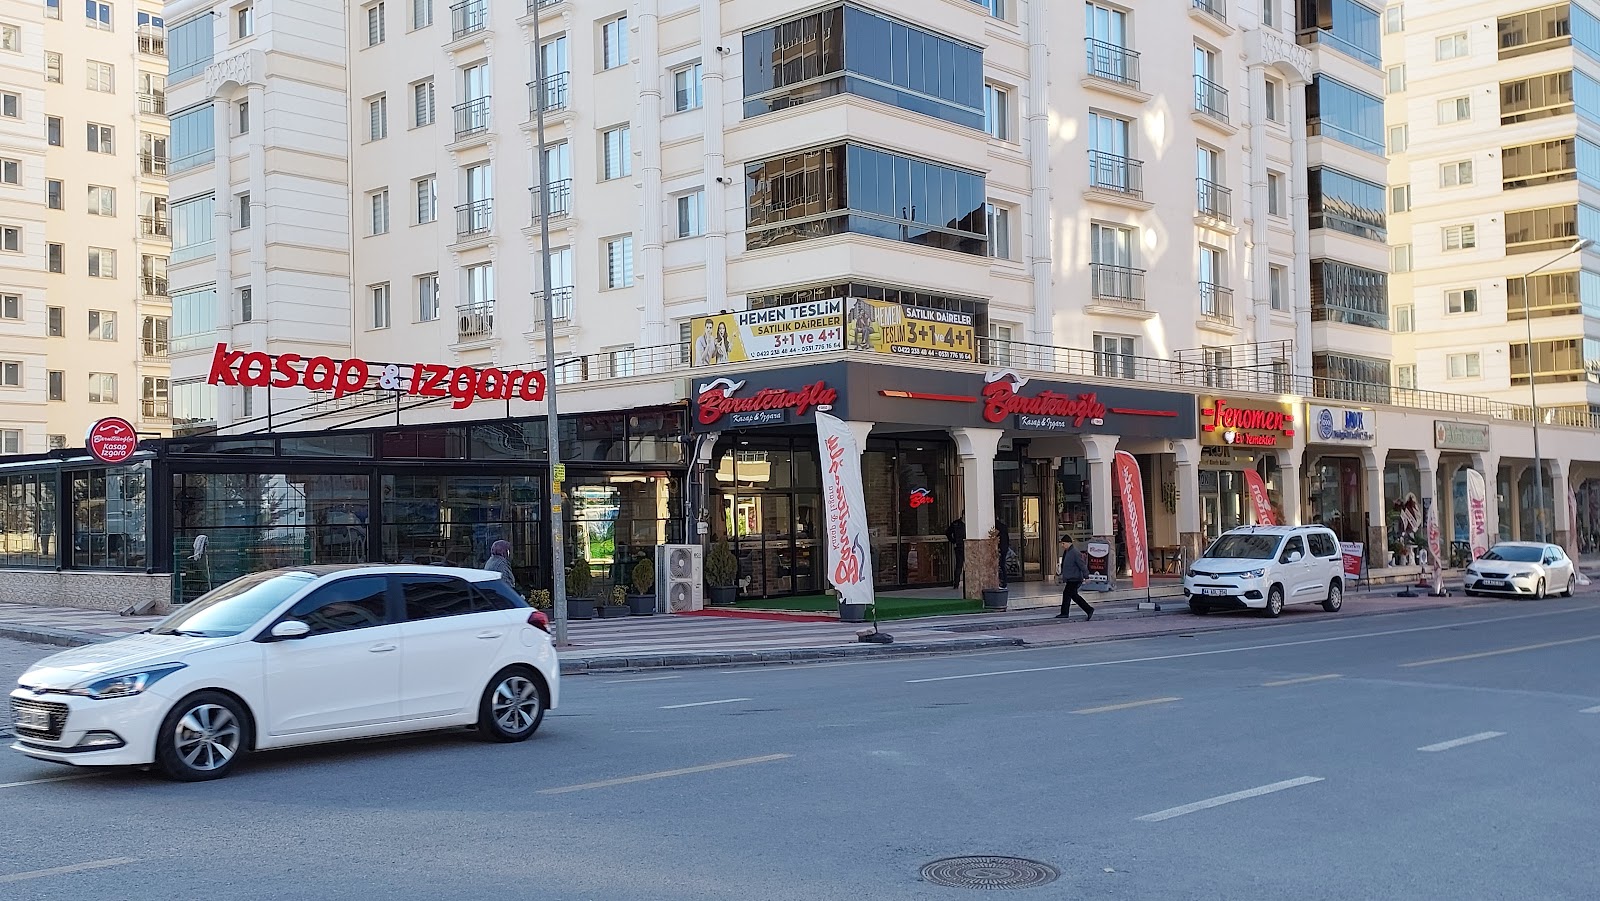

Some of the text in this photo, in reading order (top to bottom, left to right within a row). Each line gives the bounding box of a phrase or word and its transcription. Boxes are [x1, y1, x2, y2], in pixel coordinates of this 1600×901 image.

[740, 308, 786, 326] HEMEN
[874, 305, 902, 326] HEMEN
[906, 307, 935, 321] SATILIK
[758, 324, 791, 335] SATILIK
[907, 322, 936, 346] 3+1
[944, 327, 973, 350] 4+1
[774, 327, 841, 348] 3+1 ve 4+1
[897, 346, 910, 354] 0422
[207, 342, 369, 399] kasap
[379, 364, 401, 390] &
[732, 414, 753, 423] Kasap
[753, 412, 760, 421] &
[1021, 415, 1041, 428] Kasap
[1040, 417, 1046, 427] &
[1213, 399, 1284, 431] Fenomen
[1235, 431, 1277, 446] Ev Yemekleri
[103, 443, 128, 451] Kasap
